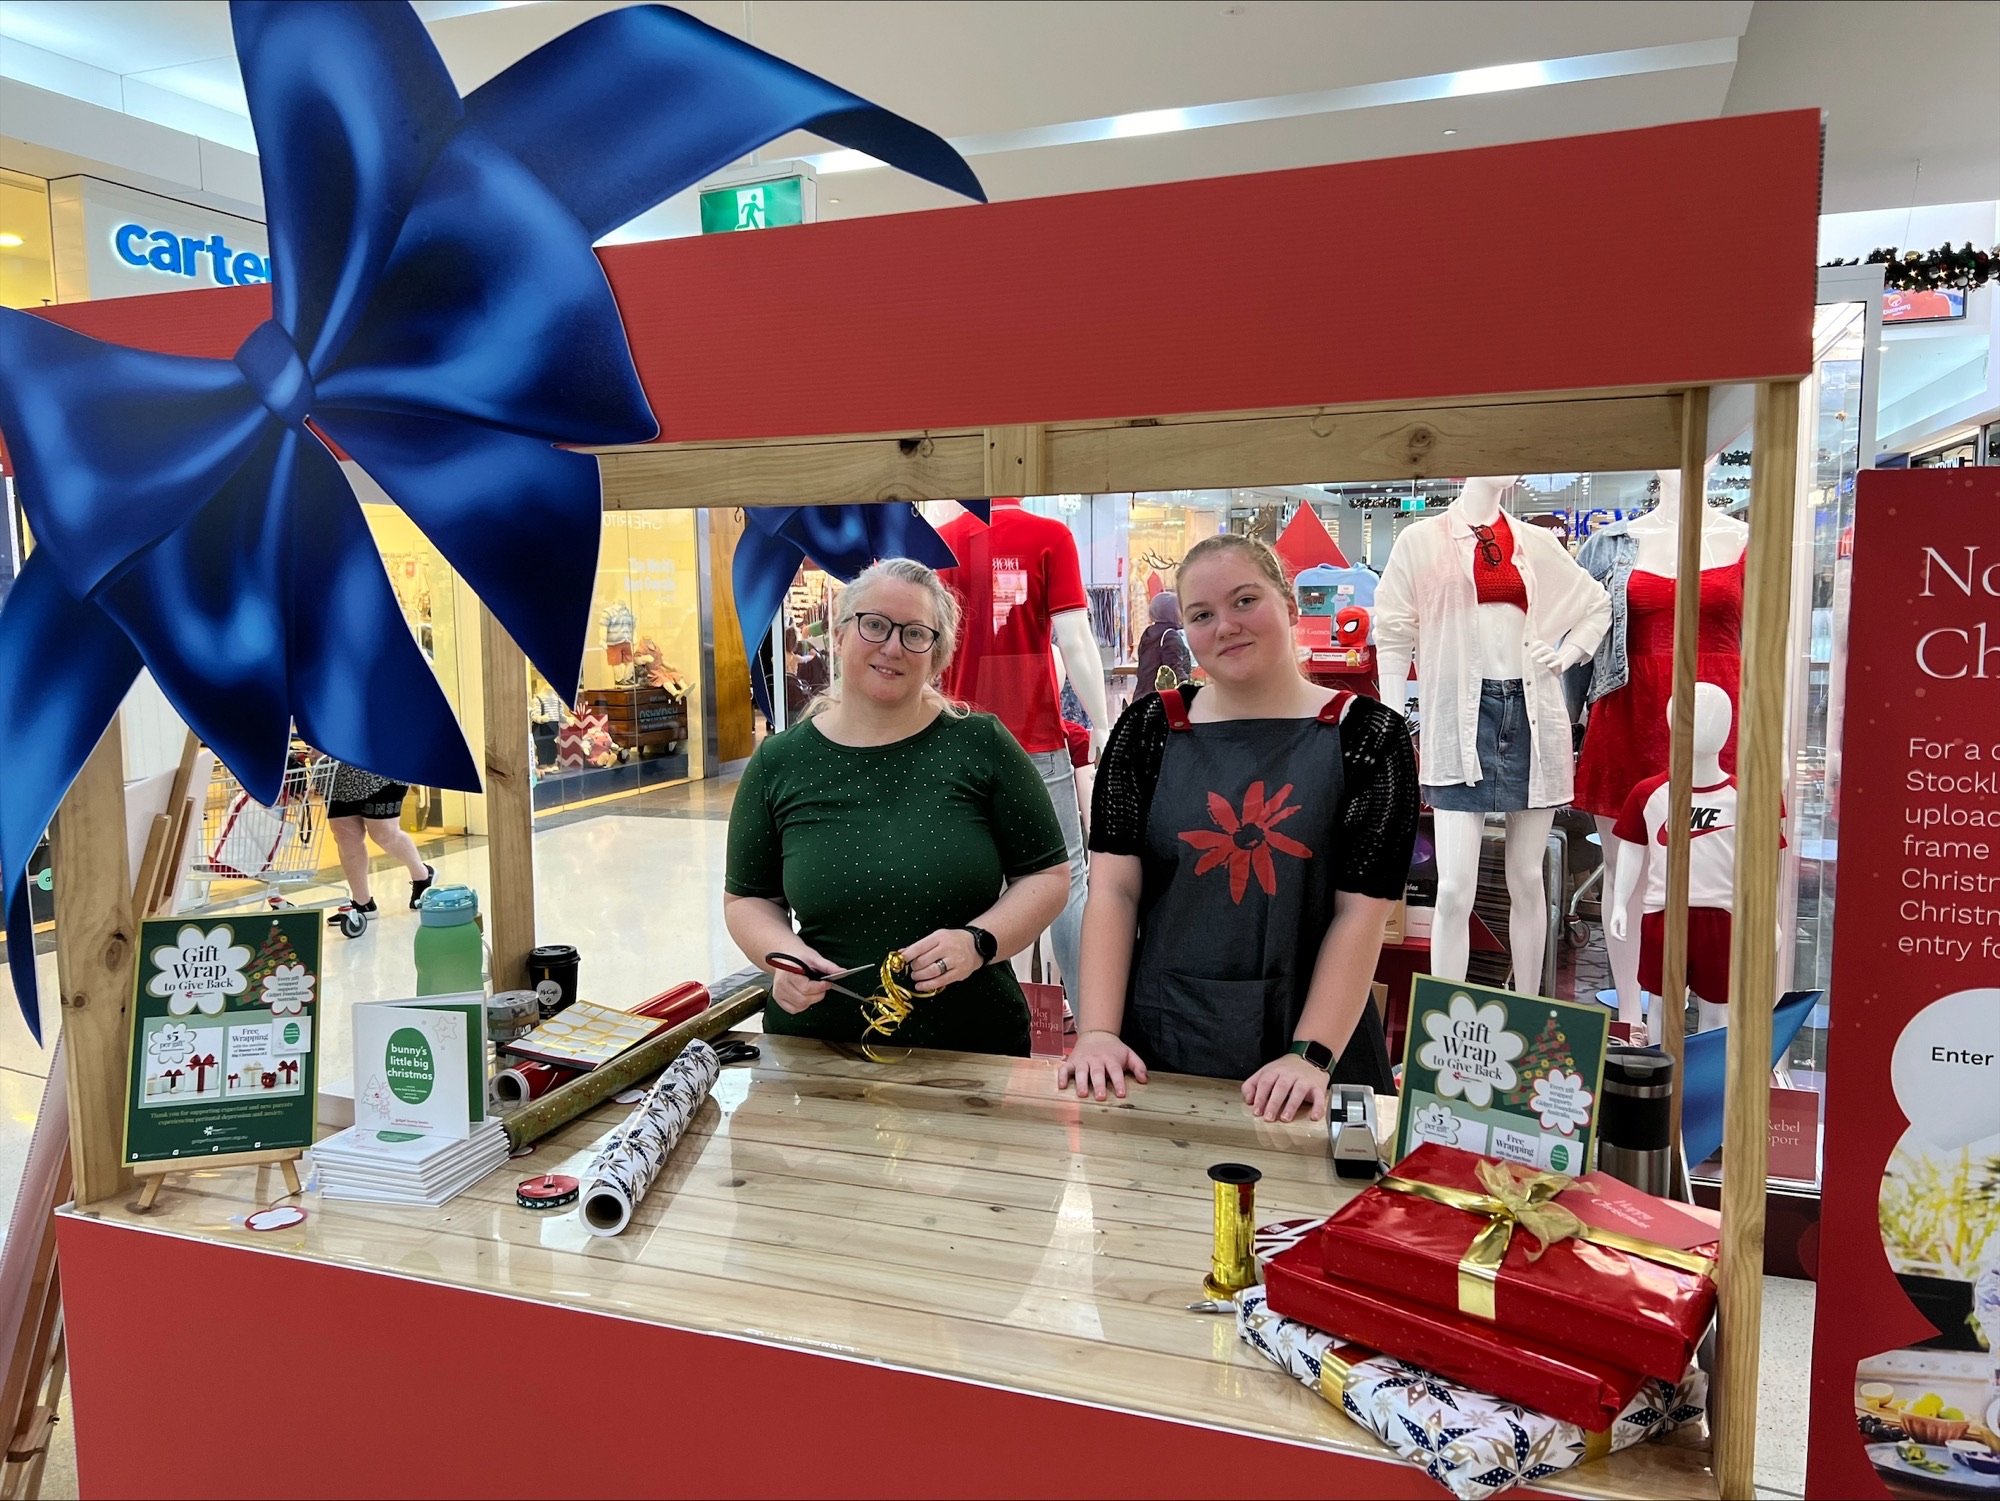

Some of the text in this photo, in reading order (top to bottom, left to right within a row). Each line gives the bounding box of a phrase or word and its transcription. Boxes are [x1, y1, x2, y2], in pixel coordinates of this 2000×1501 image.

[1909, 738, 1956, 760] For
[1964, 743, 1981, 760] a
[1690, 807, 1721, 829] KE
[1903, 834, 1989, 860] frame
[182, 945, 220, 964] Gift
[1898, 936, 1972, 962] entry
[173, 963, 227, 980] Wrap
[164, 977, 233, 991] to Give Back
[1031, 1008, 1048, 1018] Plot
[1030, 1019, 1059, 1032] othing
[1453, 1020, 1491, 1044] Gift
[166, 1031, 179, 1041] $5
[232, 1034, 269, 1043] Wrapping
[391, 1043, 427, 1057] bunny's
[1443, 1035, 1497, 1067] Wrap
[1932, 1046, 1994, 1066] Enter
[390, 1056, 429, 1070] little big
[1433, 1055, 1445, 1066] to
[1447, 1058, 1472, 1073] Give
[1475, 1064, 1503, 1081] Back
[387, 1067, 433, 1080] christmas
[190, 1108, 220, 1116] supporting
[158, 1117, 194, 1126] experiencing
[1431, 1114, 1443, 1125] $5
[1507, 1134, 1525, 1147] Free
[1496, 1139, 1534, 1157] Wrapping
